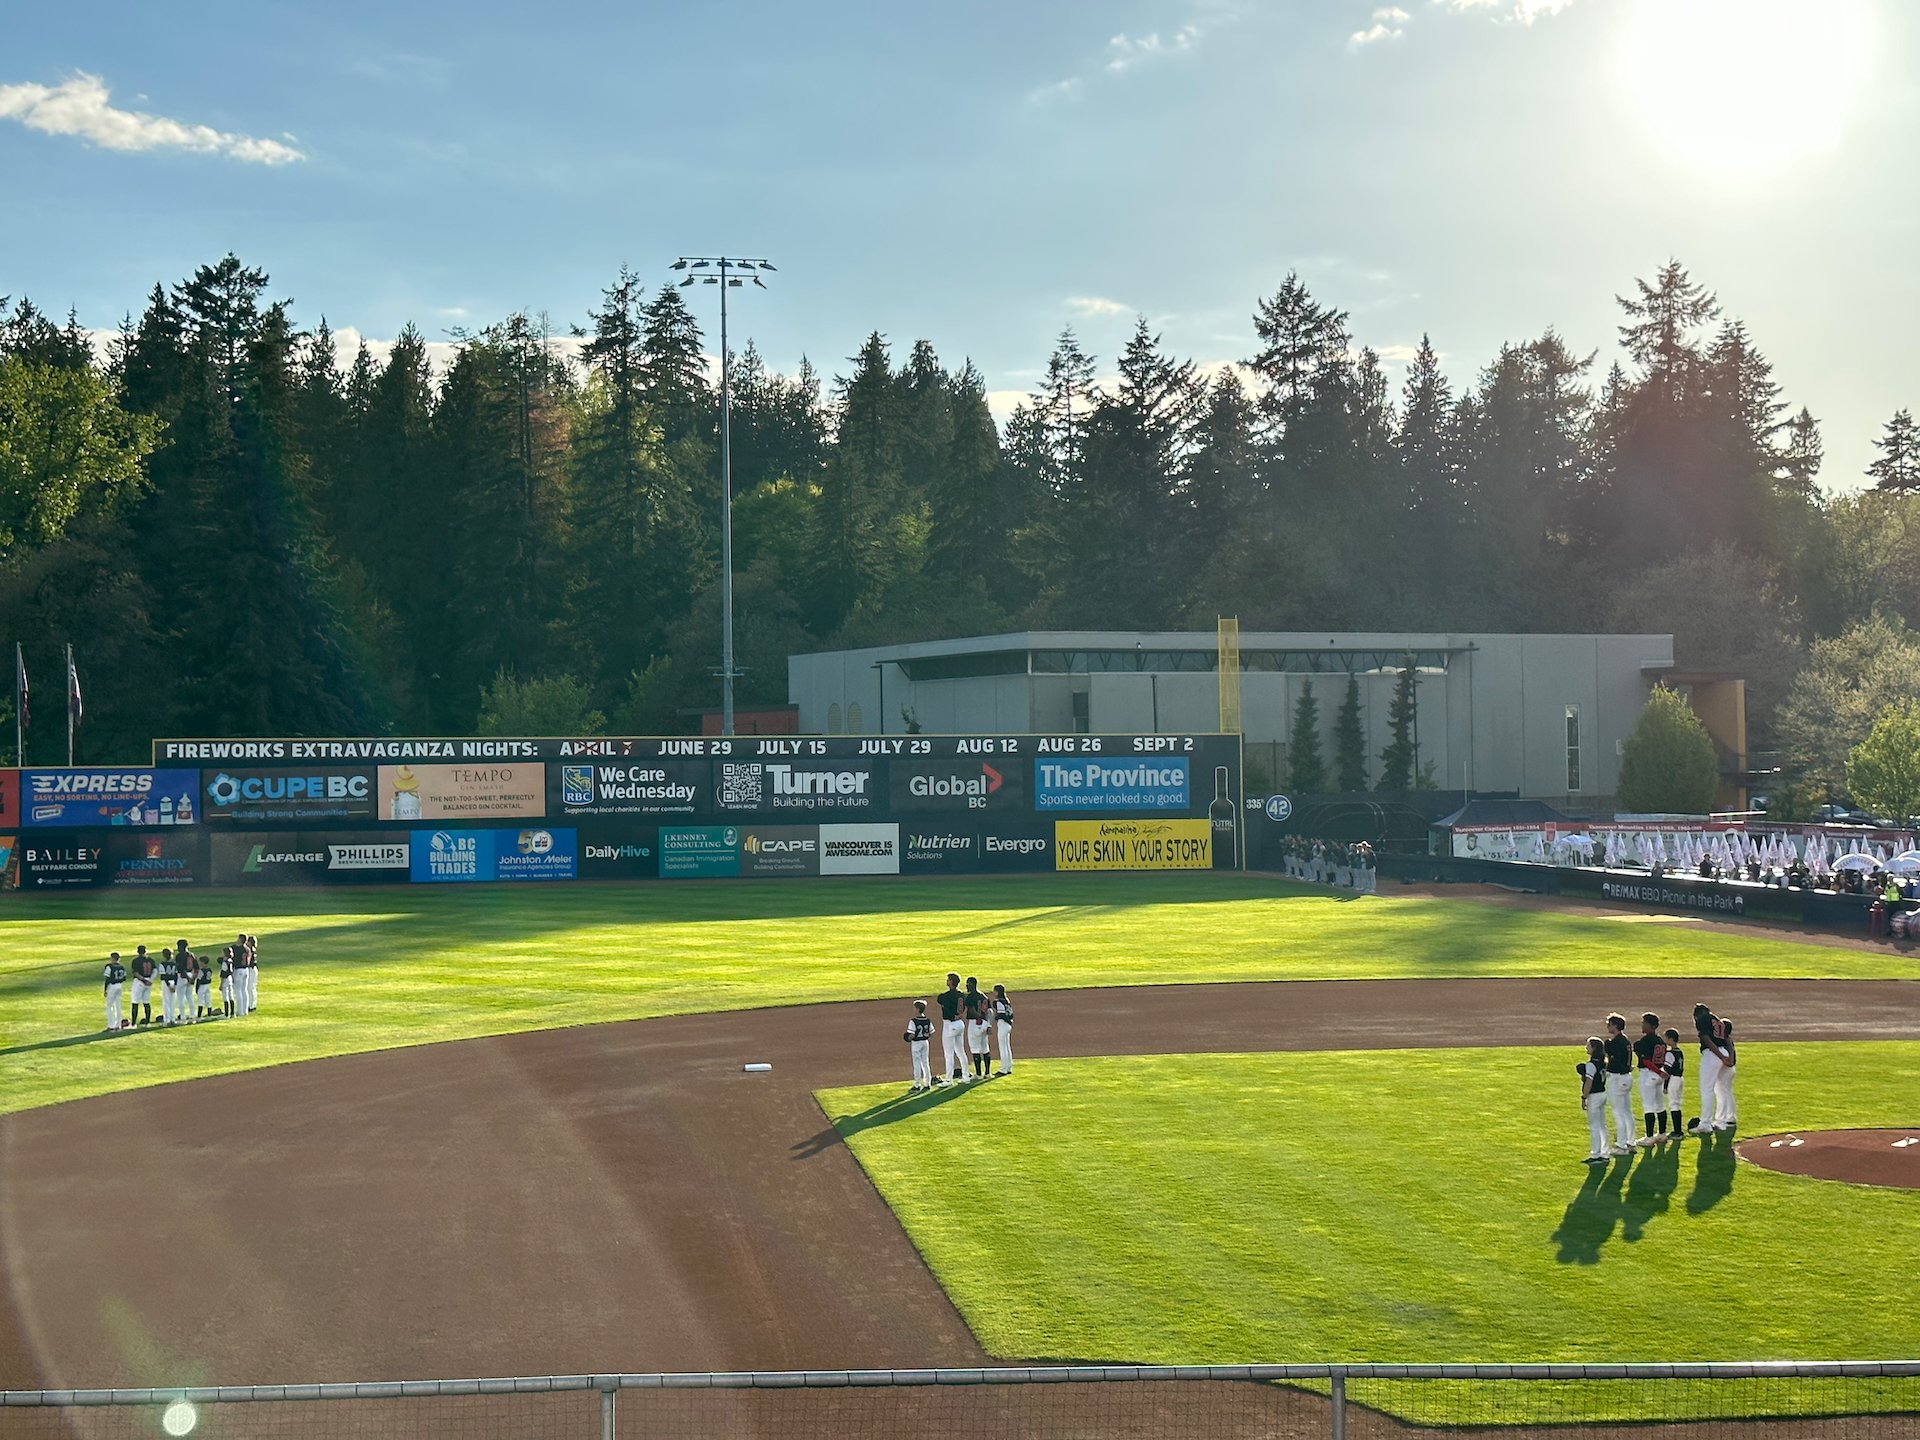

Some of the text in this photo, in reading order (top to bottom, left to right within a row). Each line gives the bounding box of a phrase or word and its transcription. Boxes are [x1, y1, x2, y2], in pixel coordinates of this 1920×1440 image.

[166, 743, 285, 758] FIREWORKS
[291, 742, 456, 758] EXTRAVAGANZA
[462, 742, 539, 757] NIGHTS:
[657, 741, 704, 756] JUNE
[710, 741, 732, 755] 29
[756, 741, 802, 755] JULY
[808, 740, 827, 755] 15
[858, 740, 904, 755] JULY
[910, 740, 932, 754] 29
[956, 739, 994, 753] AUG
[1001, 739, 1018, 753] 12
[1037, 738, 1075, 752] AUG
[1081, 738, 1102, 752] 26
[1133, 738, 1178, 751] SEPT
[1184, 738, 1194, 751] 2
[452, 768, 513, 783] TEMPO
[598, 766, 665, 782] We Care
[765, 764, 870, 795] Turner
[1040, 764, 1184, 788] The Province
[31, 774, 153, 793] EXPRESS
[241, 776, 369, 799] CUPE BC
[909, 775, 987, 796] Global
[566, 792, 591, 802] RBC
[599, 783, 697, 802] Wednesday
[773, 797, 869, 809] Building the Future
[968, 797, 987, 808] BC
[1039, 792, 1186, 807] Sports never looked so good.
[442, 803, 477, 811] BALANCED
[564, 806, 599, 815] Supporting
[661, 806, 695, 814] community
[1269, 800, 1288, 815] 42
[232, 808, 348, 819] Building Strong Communities
[458, 838, 476, 850] BC
[664, 841, 721, 849] CONSULTING
[761, 840, 816, 852] CAPE
[824, 841, 881, 850] VANCOUVER
[909, 834, 971, 849] Nutrien
[986, 836, 1046, 854] Evergro
[26, 849, 100, 862] BAILEY
[337, 848, 404, 860] PHILLIPS
[429, 851, 476, 862] BUILDING
[825, 849, 893, 857] AWESOME.COM
[907, 851, 943, 859] Solutions
[1058, 839, 1208, 862] YOUR SKIN YOUR STORY
[257, 853, 324, 863] LAFARGE
[499, 855, 572, 865] Johnston Meier
[120, 859, 187, 870] PENNEY
[430, 862, 476, 875] TRADES
[1610, 884, 1734, 909] RE/MAX BBQ Picnic in the Park
